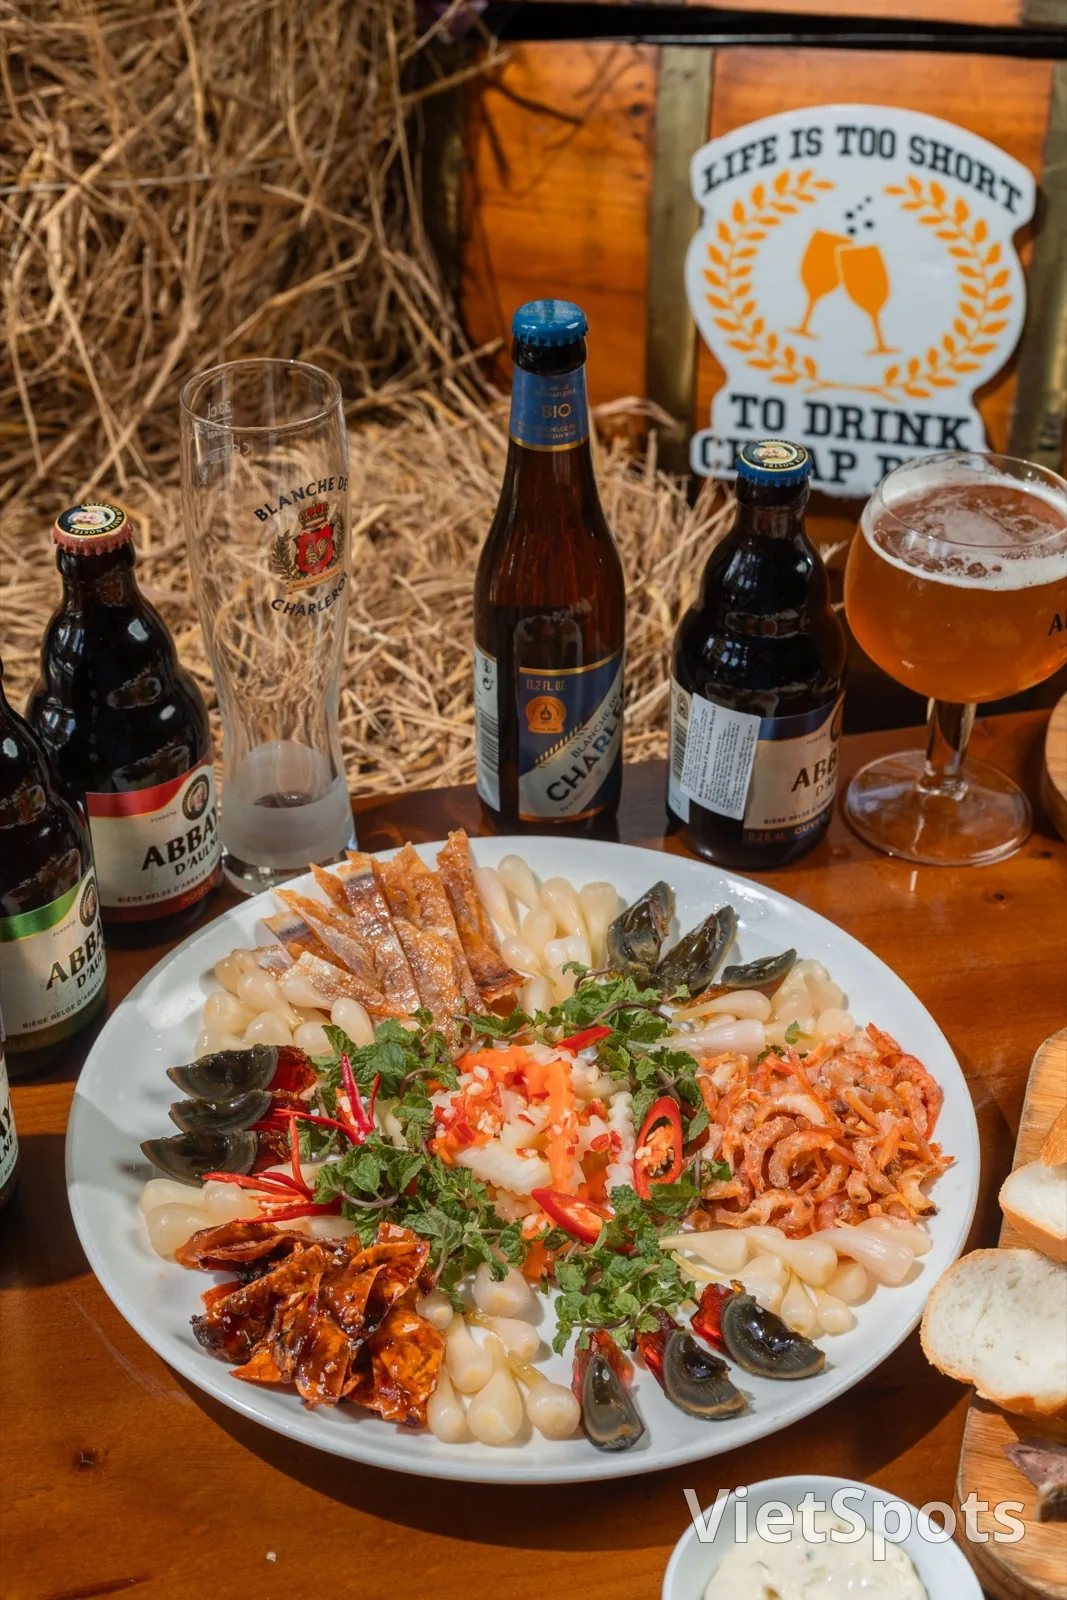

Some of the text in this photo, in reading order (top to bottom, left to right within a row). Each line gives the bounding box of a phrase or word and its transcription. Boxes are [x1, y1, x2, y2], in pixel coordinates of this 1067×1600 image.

[702, 125, 1023, 215] LIFE IS TOO SHORT
[541, 403, 571, 418] BIO
[731, 394, 971, 451] TO DRINK
[253, 475, 348, 523] BLANCHE DE
[69, 527, 103, 536] NOSTRA
[571, 710, 611, 758] BLANCHE
